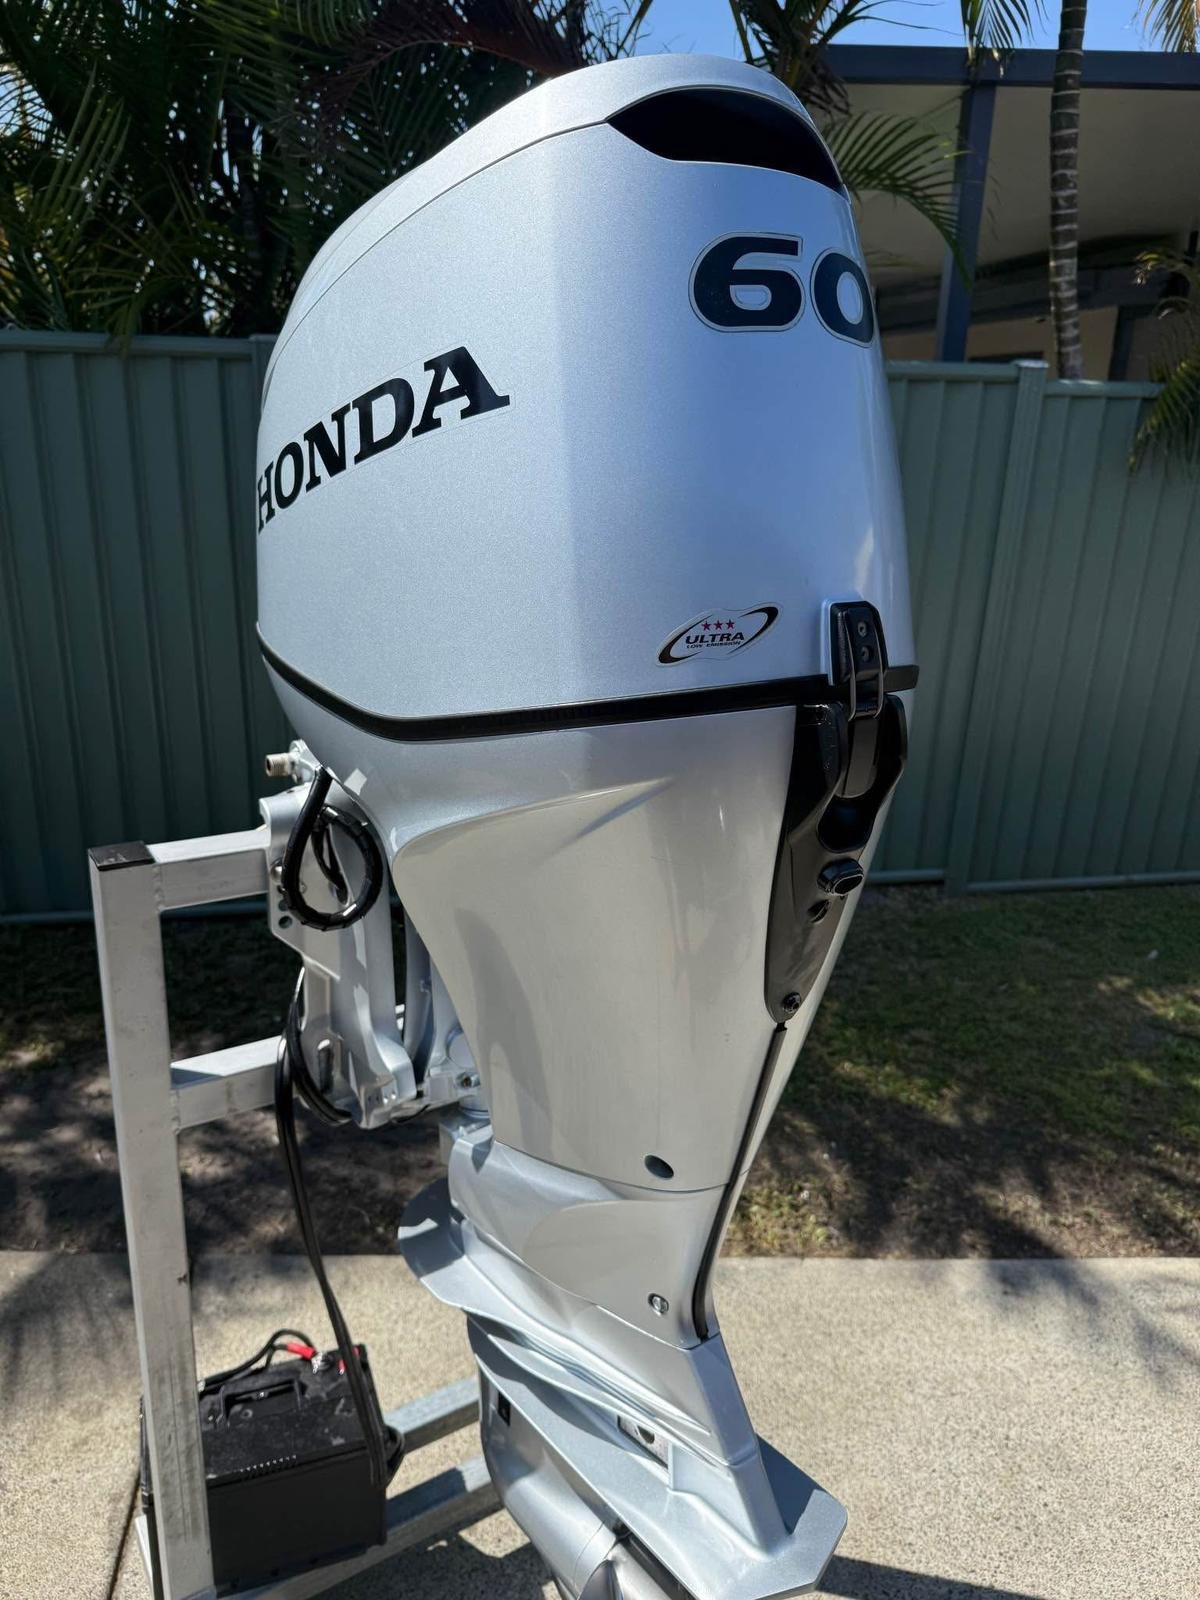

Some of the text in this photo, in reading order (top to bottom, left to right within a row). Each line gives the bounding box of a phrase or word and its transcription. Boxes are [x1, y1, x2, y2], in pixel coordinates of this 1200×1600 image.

[690, 233, 874, 347] 60
[257, 346, 510, 534] HONDA
[686, 632, 744, 644] ULTRA
